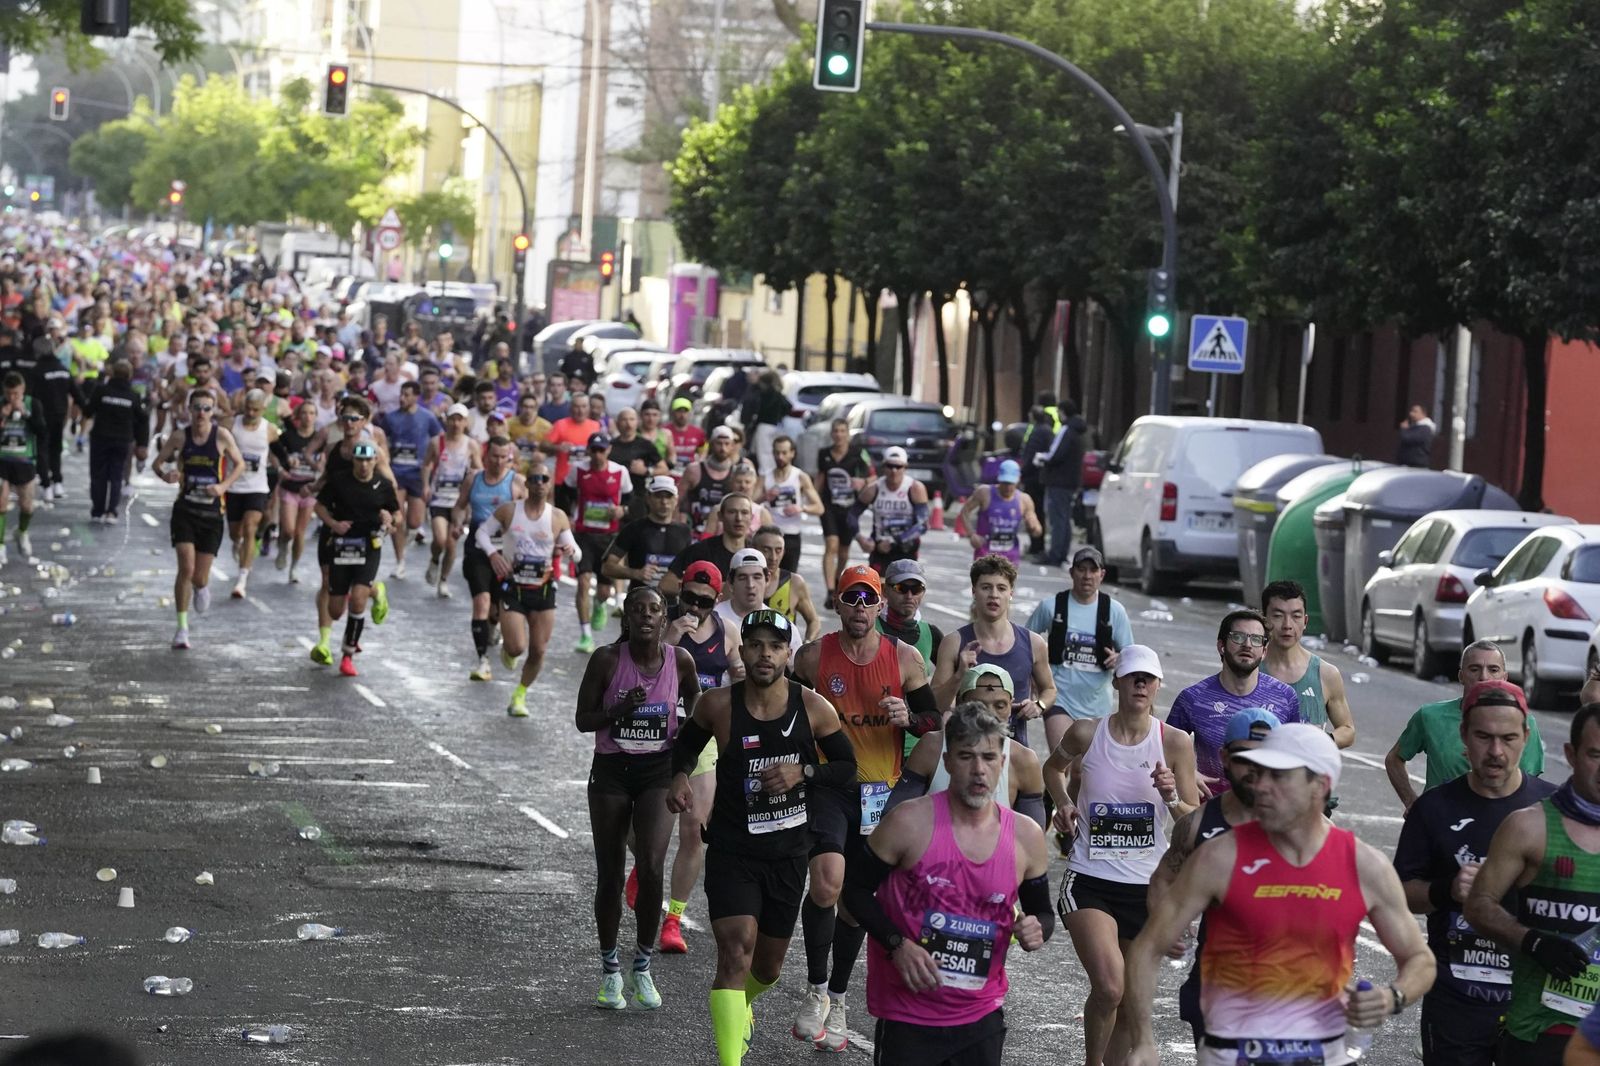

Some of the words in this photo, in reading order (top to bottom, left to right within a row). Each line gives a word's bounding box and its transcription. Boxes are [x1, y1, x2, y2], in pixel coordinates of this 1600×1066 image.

[620, 728, 660, 739] MAGALI
[769, 794, 787, 805] 5018
[748, 812, 770, 822] HUGO
[772, 803, 806, 819] VILLEGAS
[1112, 806, 1147, 815] ZURICH
[1113, 823, 1132, 831] 4776
[1090, 835, 1154, 847] ESPERANZA
[1253, 883, 1342, 900] ESPAÑA
[950, 919, 990, 934] ZURICH
[946, 940, 968, 953] 5166
[1474, 938, 1496, 950] 4941
[931, 951, 977, 973] CESAR
[1464, 949, 1510, 968] MOÑIS
